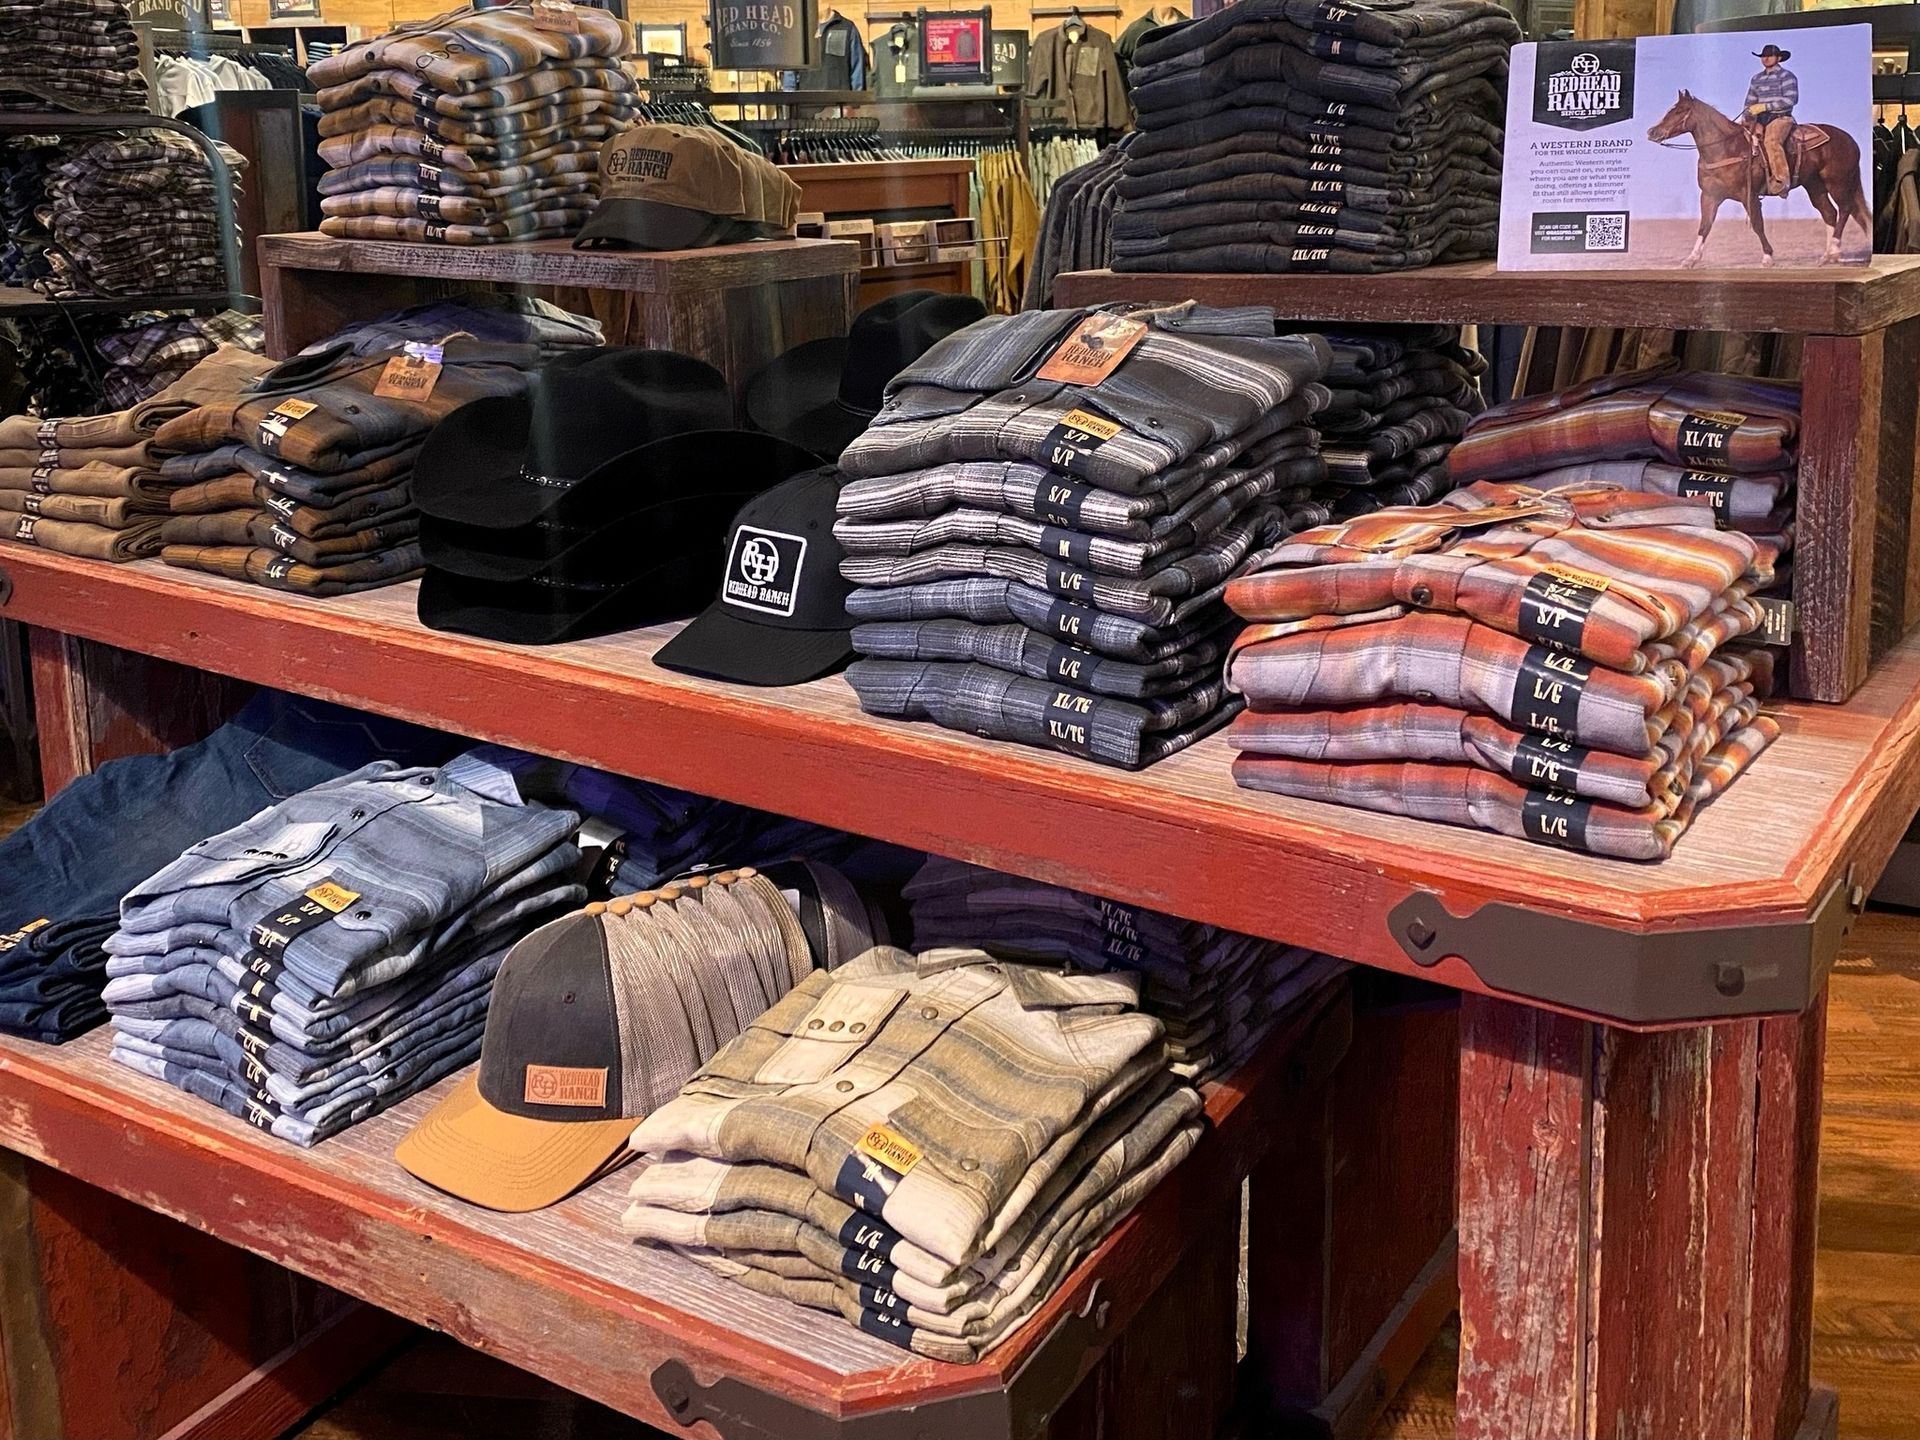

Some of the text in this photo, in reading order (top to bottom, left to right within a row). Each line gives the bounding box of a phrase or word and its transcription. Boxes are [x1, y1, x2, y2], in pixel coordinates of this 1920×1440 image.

[716, 5, 794, 33] RED HEAD
[1326, 8, 1348, 22] S/P
[725, 21, 781, 37] BRAND CO.
[752, 38, 772, 48] 1856
[993, 43, 1016, 60] EAD
[1331, 41, 1342, 54] M
[1548, 74, 1620, 94] REDHEAD
[1326, 102, 1347, 116] L/G
[1547, 91, 1620, 112] RANCH
[1540, 140, 1592, 149] WESTERN
[1594, 139, 1633, 148] BRAND
[628, 162, 668, 180] RANCH
[1310, 161, 1342, 172] XL/TG
[1310, 181, 1344, 192] XL/TG
[1062, 354, 1106, 368] RANCH
[1064, 429, 1090, 442] S/P
[1684, 431, 1723, 448] XL/TG
[1052, 447, 1075, 466] S/P
[1689, 474, 1728, 483] XL/TG
[1048, 486, 1072, 505] S/P
[1059, 540, 1070, 557] M
[1060, 572, 1082, 590] L/G
[728, 580, 790, 606] REDHEAD RANCH
[1060, 614, 1080, 634] L/G
[1537, 604, 1568, 628] S/P
[1059, 658, 1081, 678] L/G
[1544, 652, 1576, 671] L/G
[1534, 678, 1563, 704] L/G
[1052, 693, 1092, 714] XL/TG
[1531, 712, 1558, 732] L/G
[1049, 720, 1085, 744] XL/TG
[1541, 738, 1571, 752] L/G
[1531, 757, 1560, 781] L/G
[1541, 814, 1568, 837] L/G
[300, 902, 323, 915] S/P
[1101, 900, 1132, 926] XL/TG
[276, 914, 301, 926] S/P
[1108, 918, 1138, 942] XL/TG
[1108, 938, 1143, 960] XL/TG
[251, 958, 271, 976] S/P
[560, 1073, 600, 1088] REDHEAD
[560, 1087, 598, 1100] RANCH
[854, 1225, 884, 1249] L/G
[857, 1251, 884, 1274] L/G
